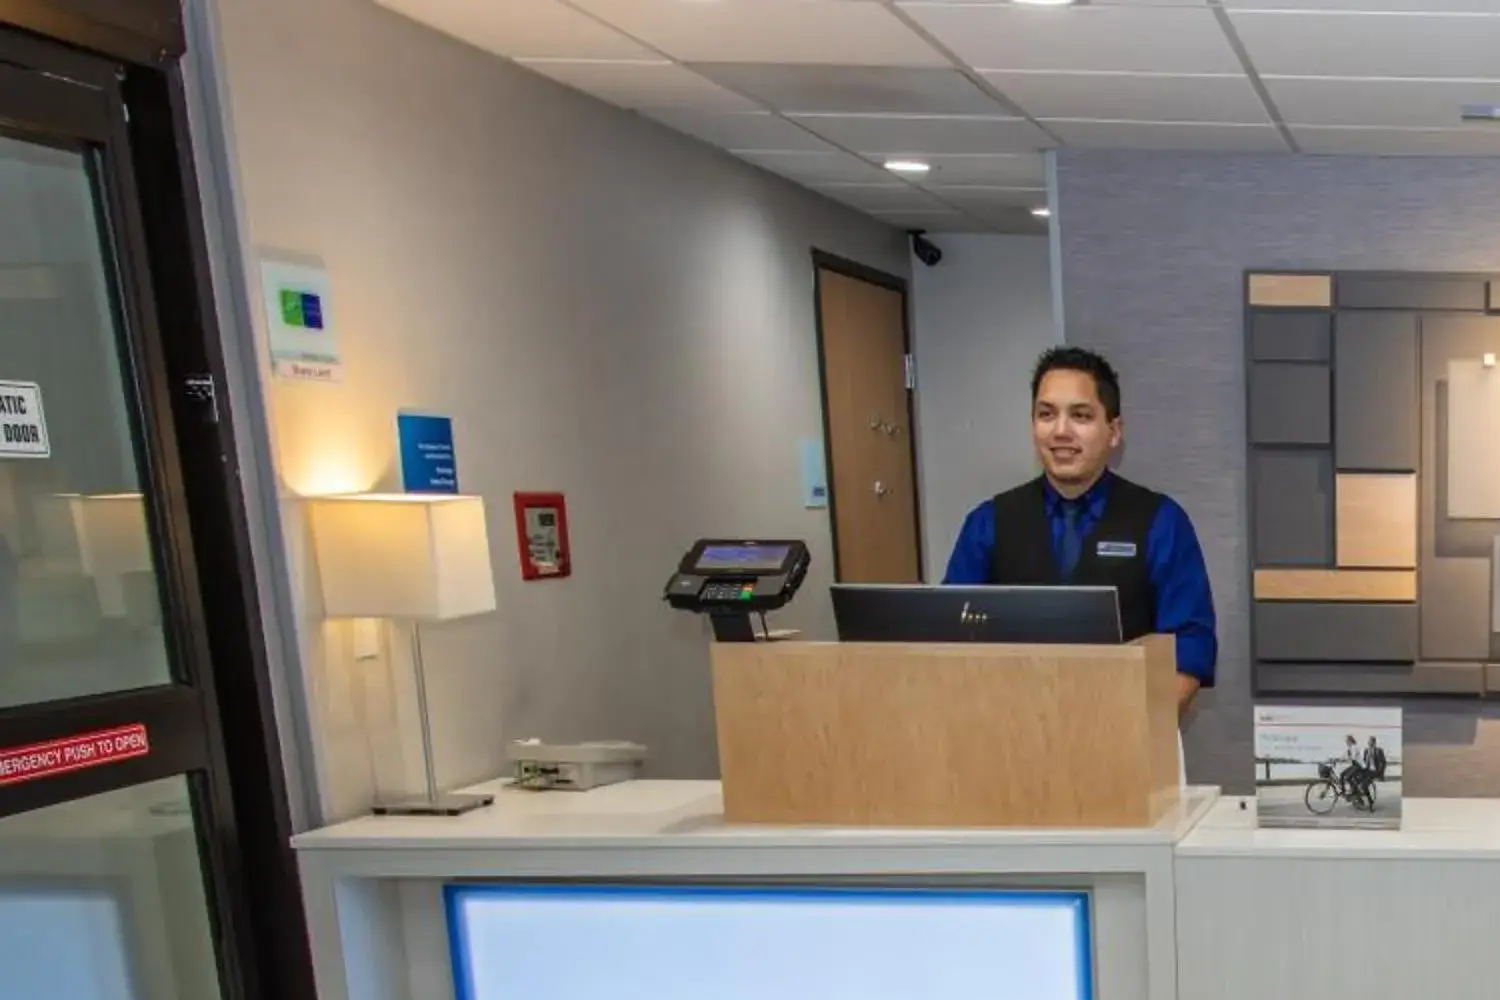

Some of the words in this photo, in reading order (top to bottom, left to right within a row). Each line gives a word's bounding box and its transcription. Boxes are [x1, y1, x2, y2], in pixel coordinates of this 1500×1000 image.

[3, 423, 40, 443] DOOR
[64, 742, 96, 763] PUSH
[97, 739, 113, 754] TO
[115, 733, 145, 751] OPEN
